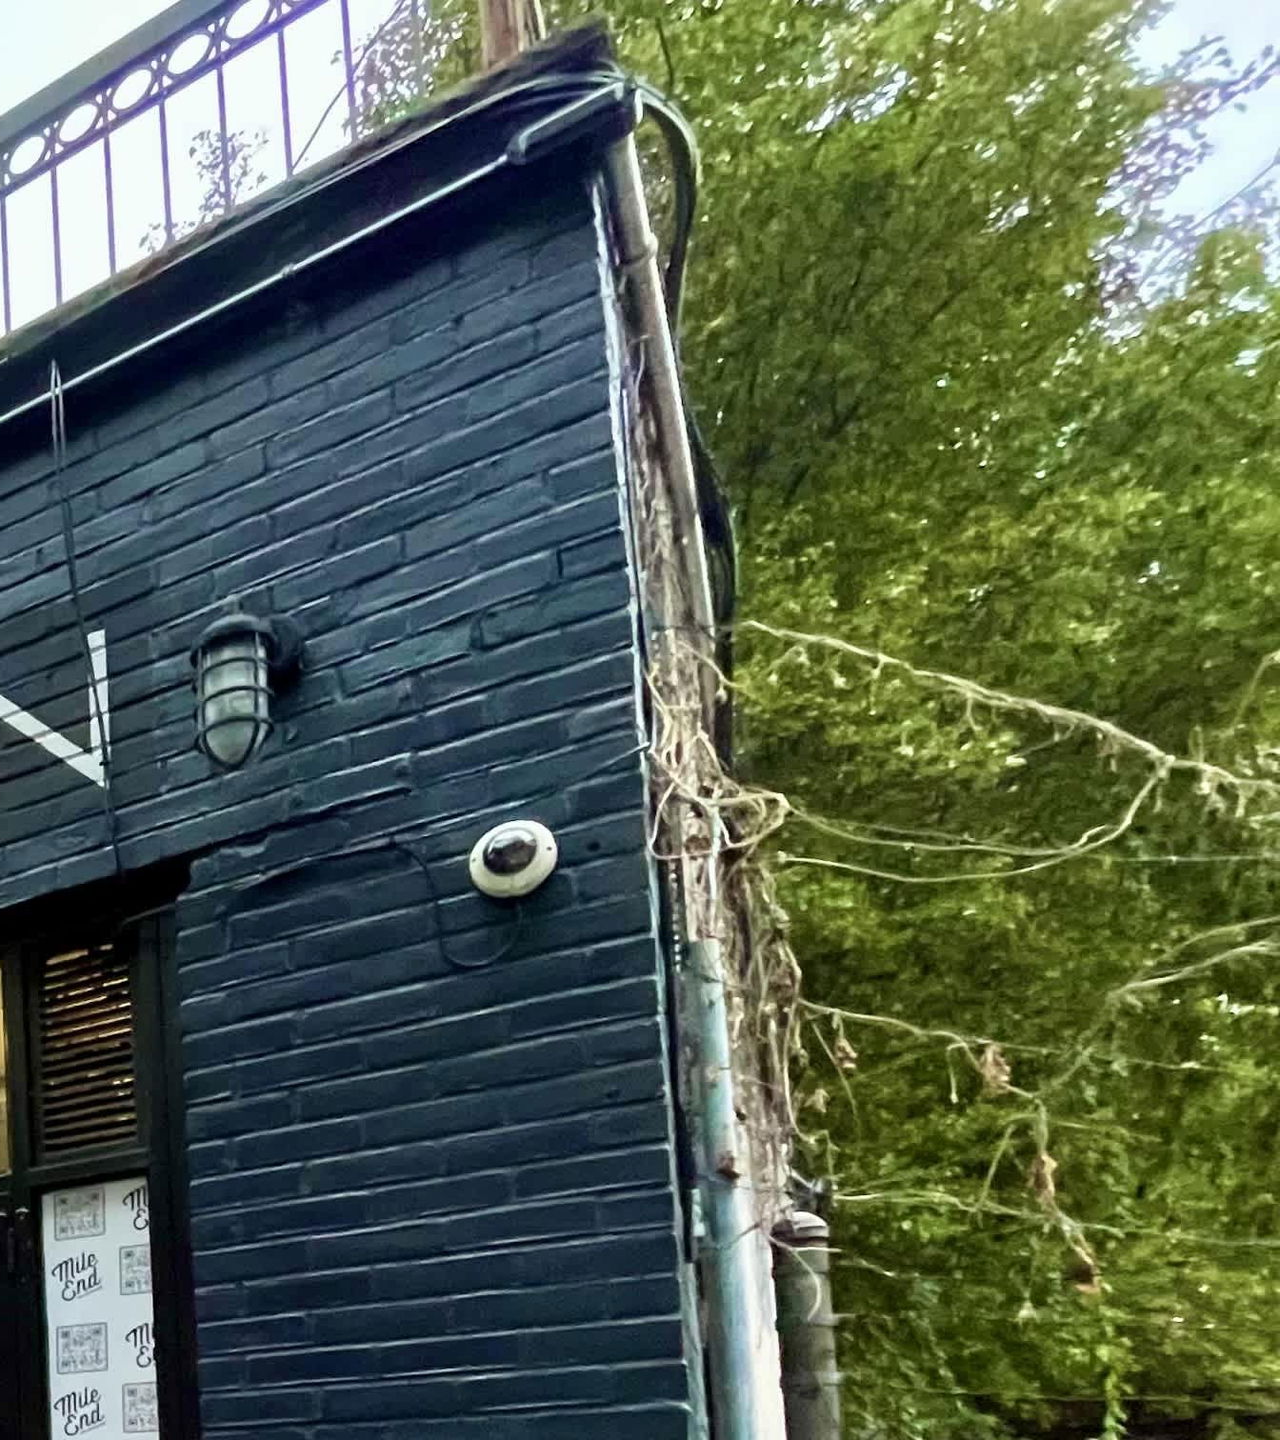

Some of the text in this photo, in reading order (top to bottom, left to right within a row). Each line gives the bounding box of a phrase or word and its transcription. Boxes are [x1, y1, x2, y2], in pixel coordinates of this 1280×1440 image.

[52, 1252, 98, 1281] Mile
[62, 1268, 100, 1301] End
[54, 1387, 100, 1416] Mile
[64, 1403, 104, 1436] End
